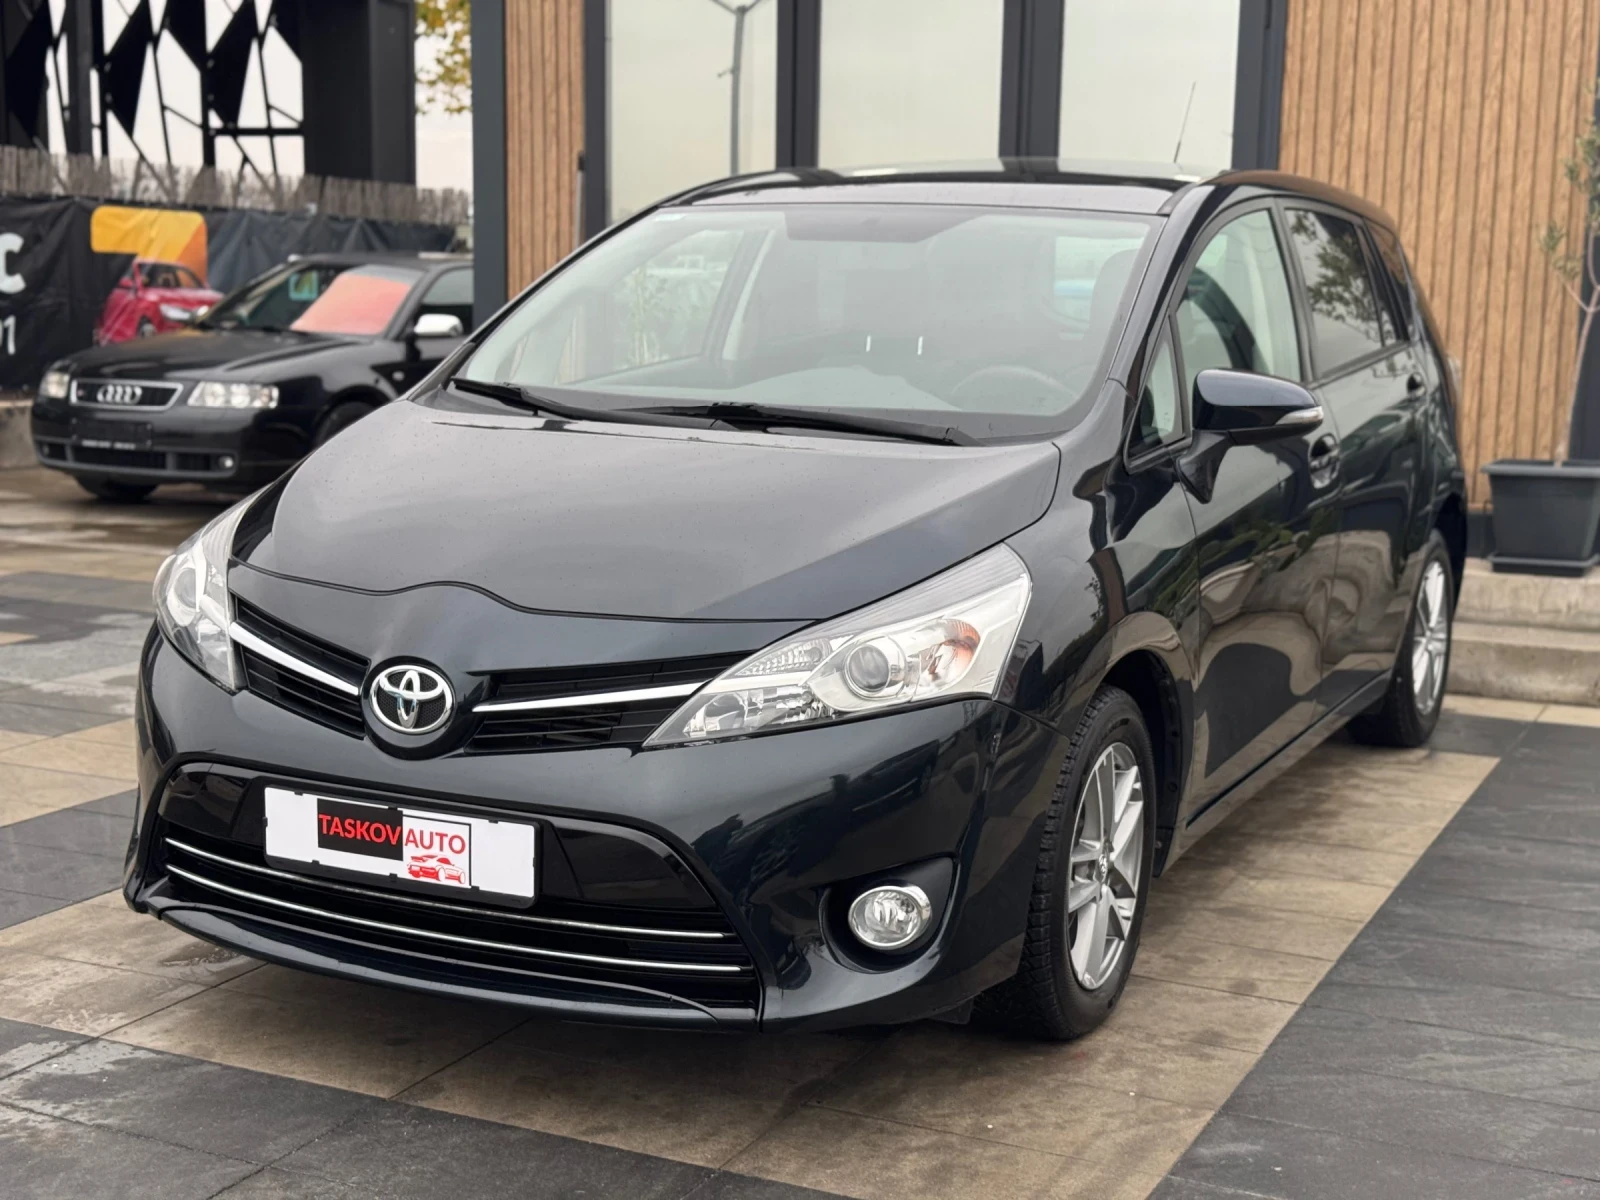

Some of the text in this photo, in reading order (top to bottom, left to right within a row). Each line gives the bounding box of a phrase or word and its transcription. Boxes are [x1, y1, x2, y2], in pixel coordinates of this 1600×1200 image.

[0, 315, 16, 355] 1
[318, 813, 466, 855] TASKOV AUTO
